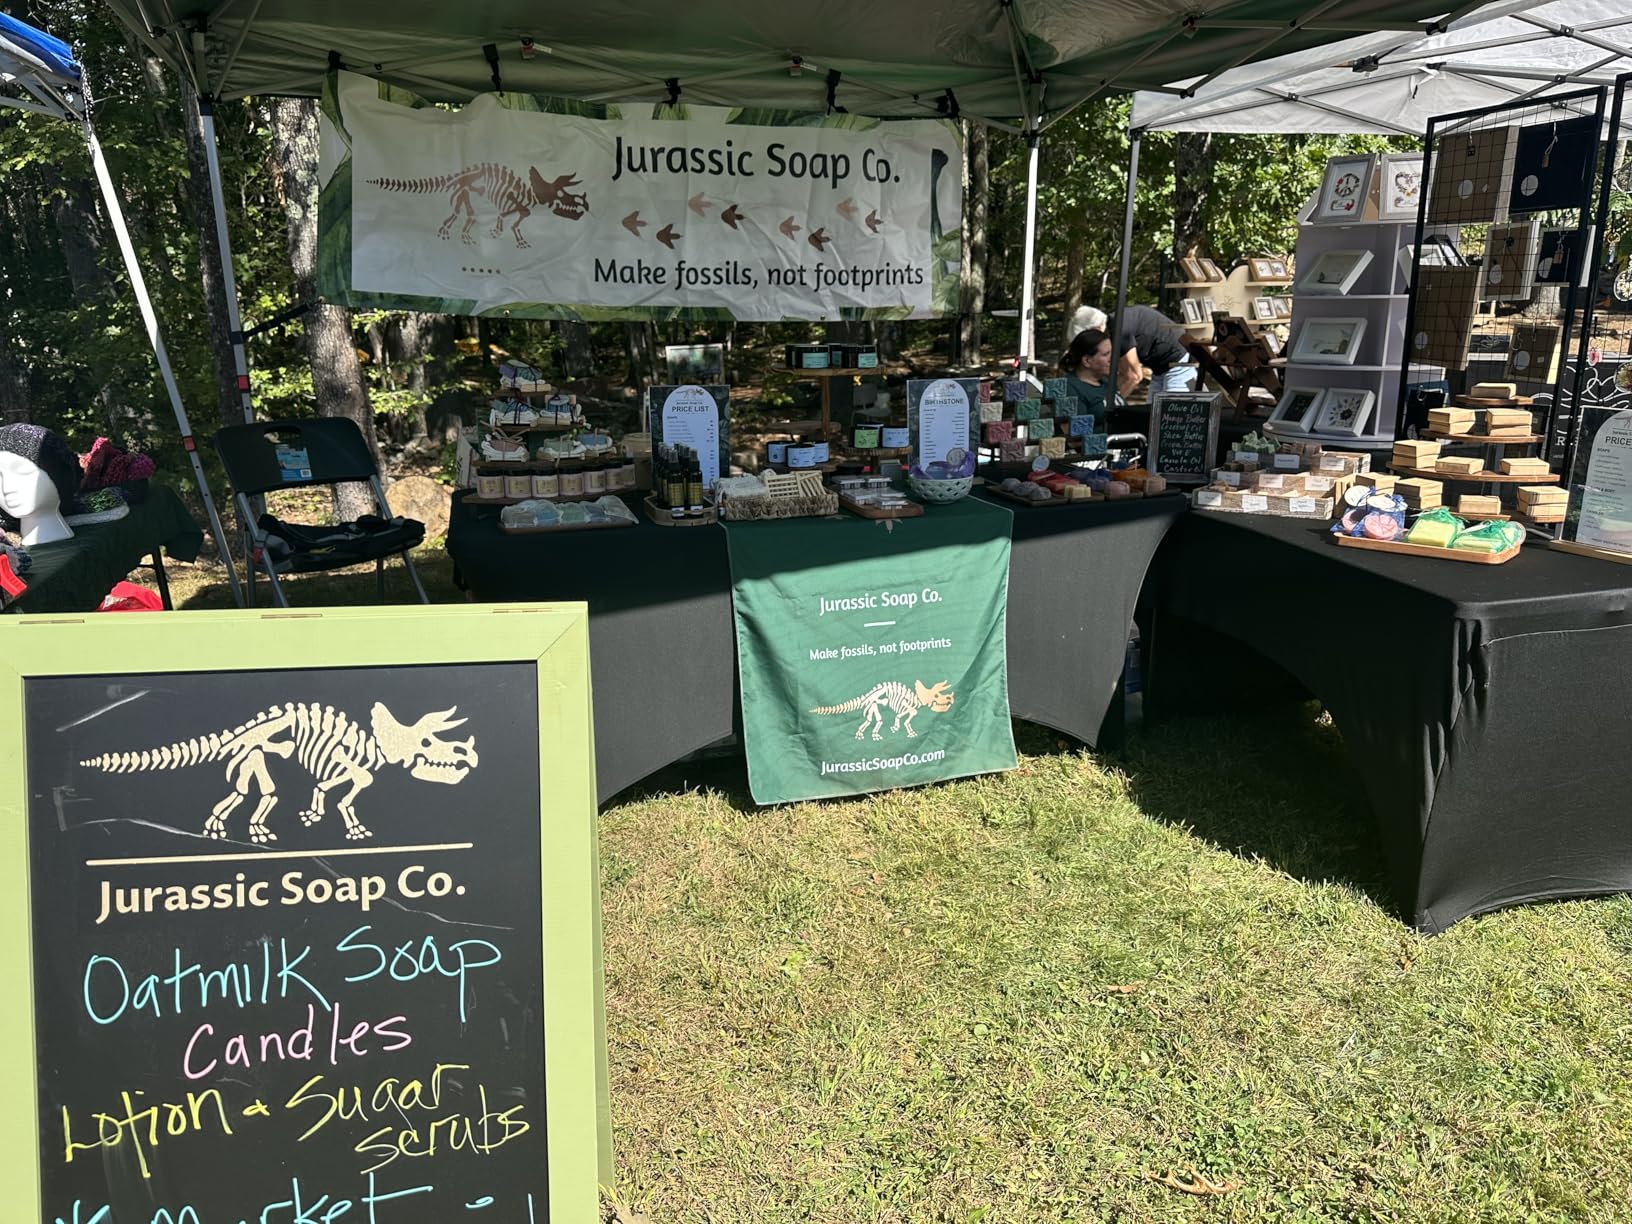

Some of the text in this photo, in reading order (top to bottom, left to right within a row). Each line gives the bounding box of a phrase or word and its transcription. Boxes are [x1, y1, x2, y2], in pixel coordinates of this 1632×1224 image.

[612, 137, 901, 189] Jurassic Soap Co.
[595, 258, 923, 292] Make fossils, not footprints
[1168, 403, 1188, 412] Olive
[1605, 435, 1632, 447] PRICE
[819, 588, 943, 616] Jurassic Soap Co.
[809, 636, 951, 661] Make fossils, not footprints
[820, 749, 945, 776] JurassicSoapCo.com
[96, 866, 466, 924] Jurassic Soap Co.
[84, 926, 502, 1024] Oatmilk Soap
[183, 1003, 412, 1080] Candles
[62, 1089, 233, 1178] Lotion
[285, 1064, 469, 1142] Sugar
